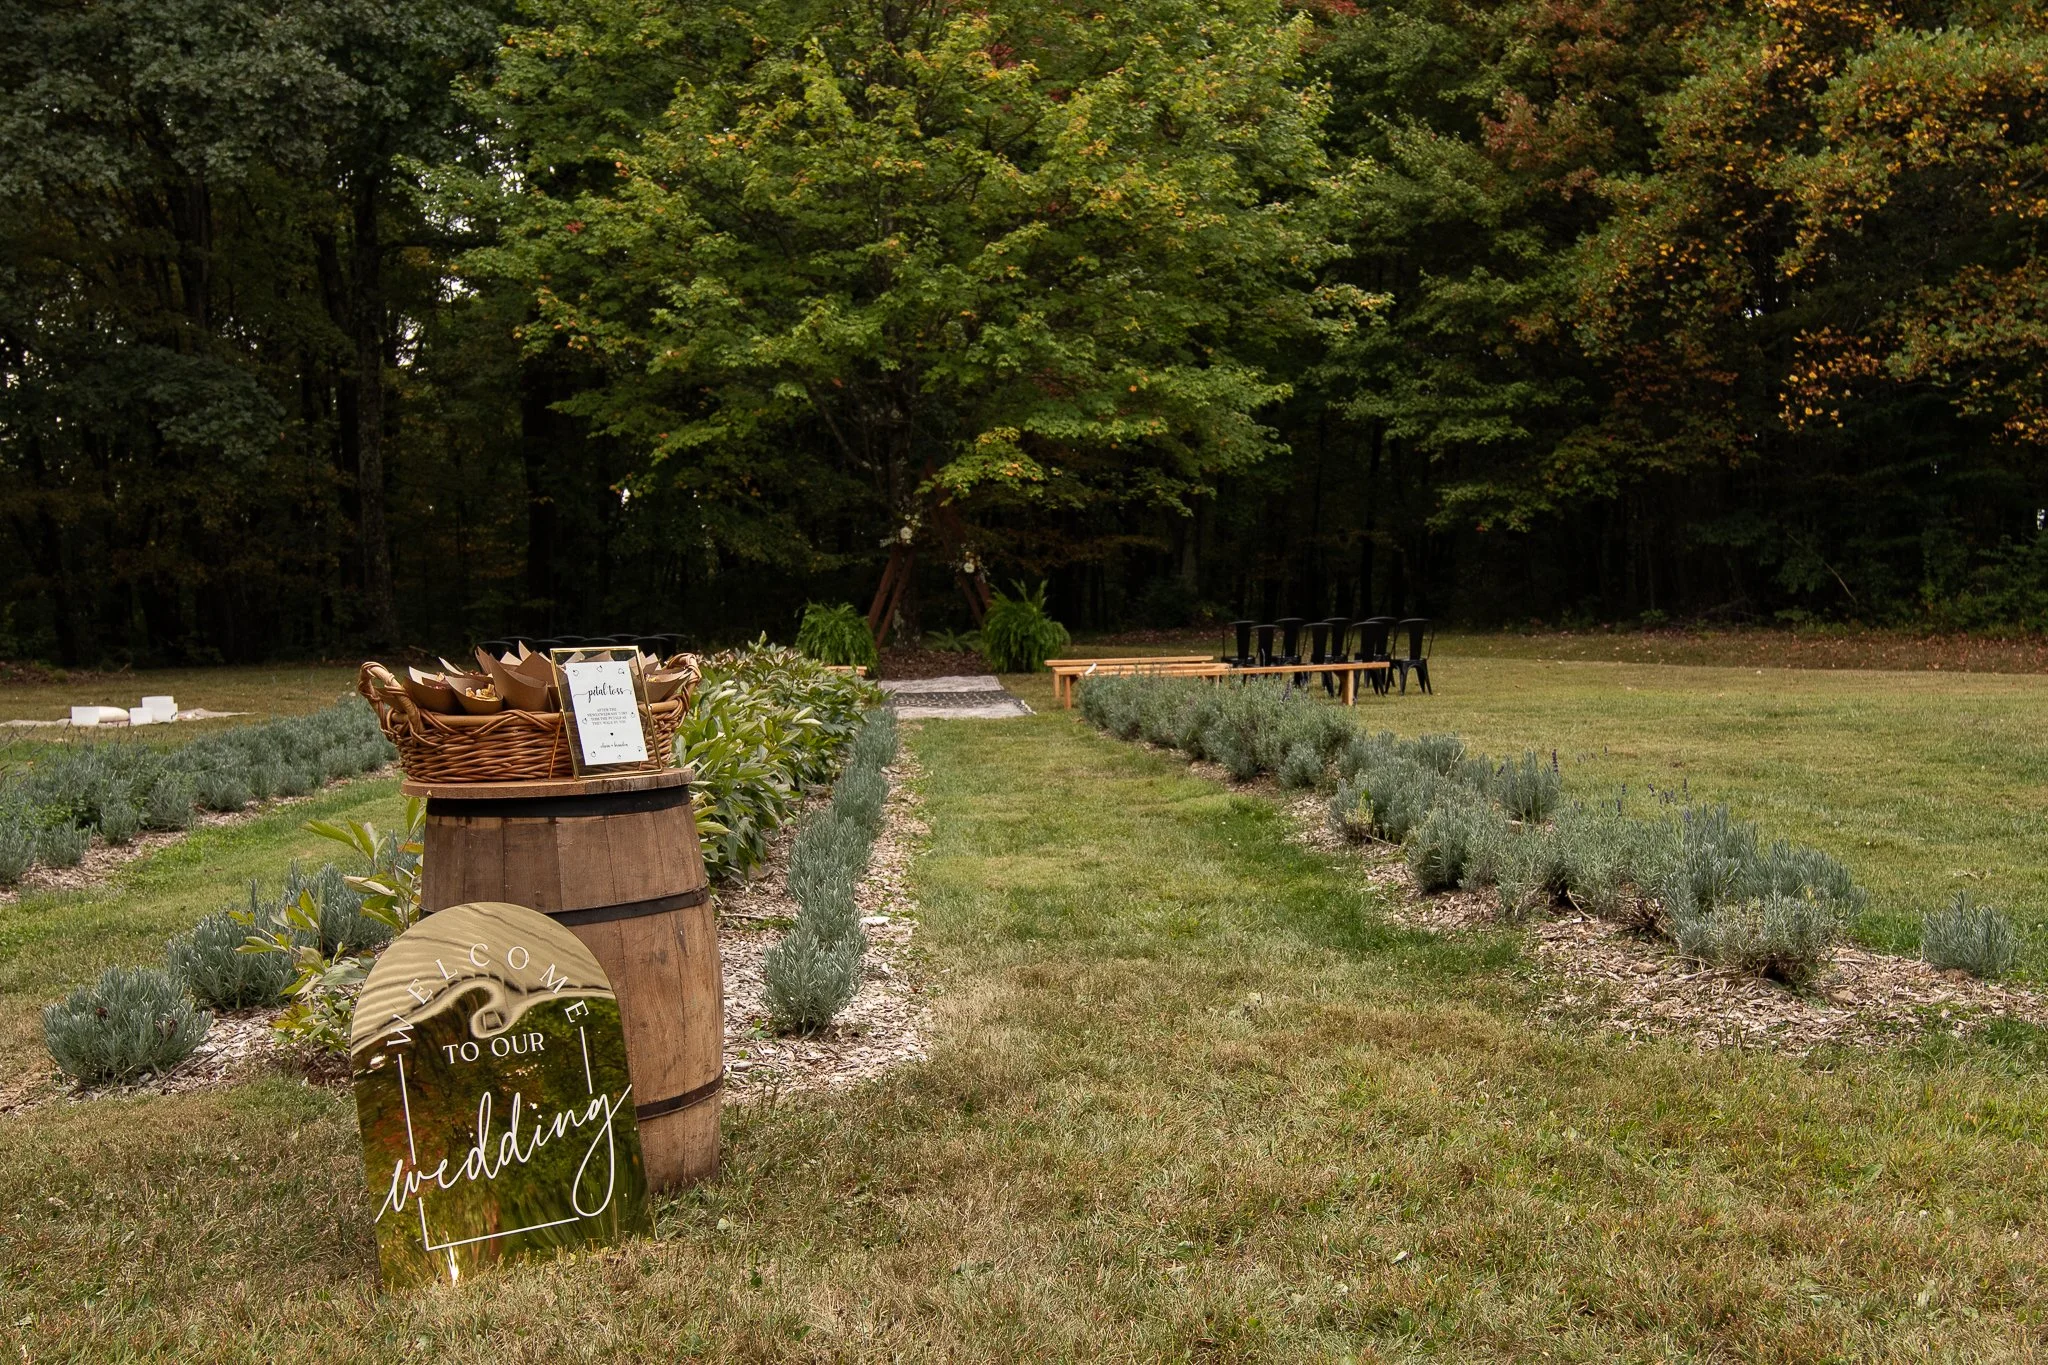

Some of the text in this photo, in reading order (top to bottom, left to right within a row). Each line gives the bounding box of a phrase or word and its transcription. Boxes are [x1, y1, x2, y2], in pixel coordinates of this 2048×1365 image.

[582, 682, 627, 703] petal toss
[386, 943, 589, 1047] WELCOME
[443, 1032, 545, 1065] TO OUR
[374, 1083, 632, 1223] wedding
